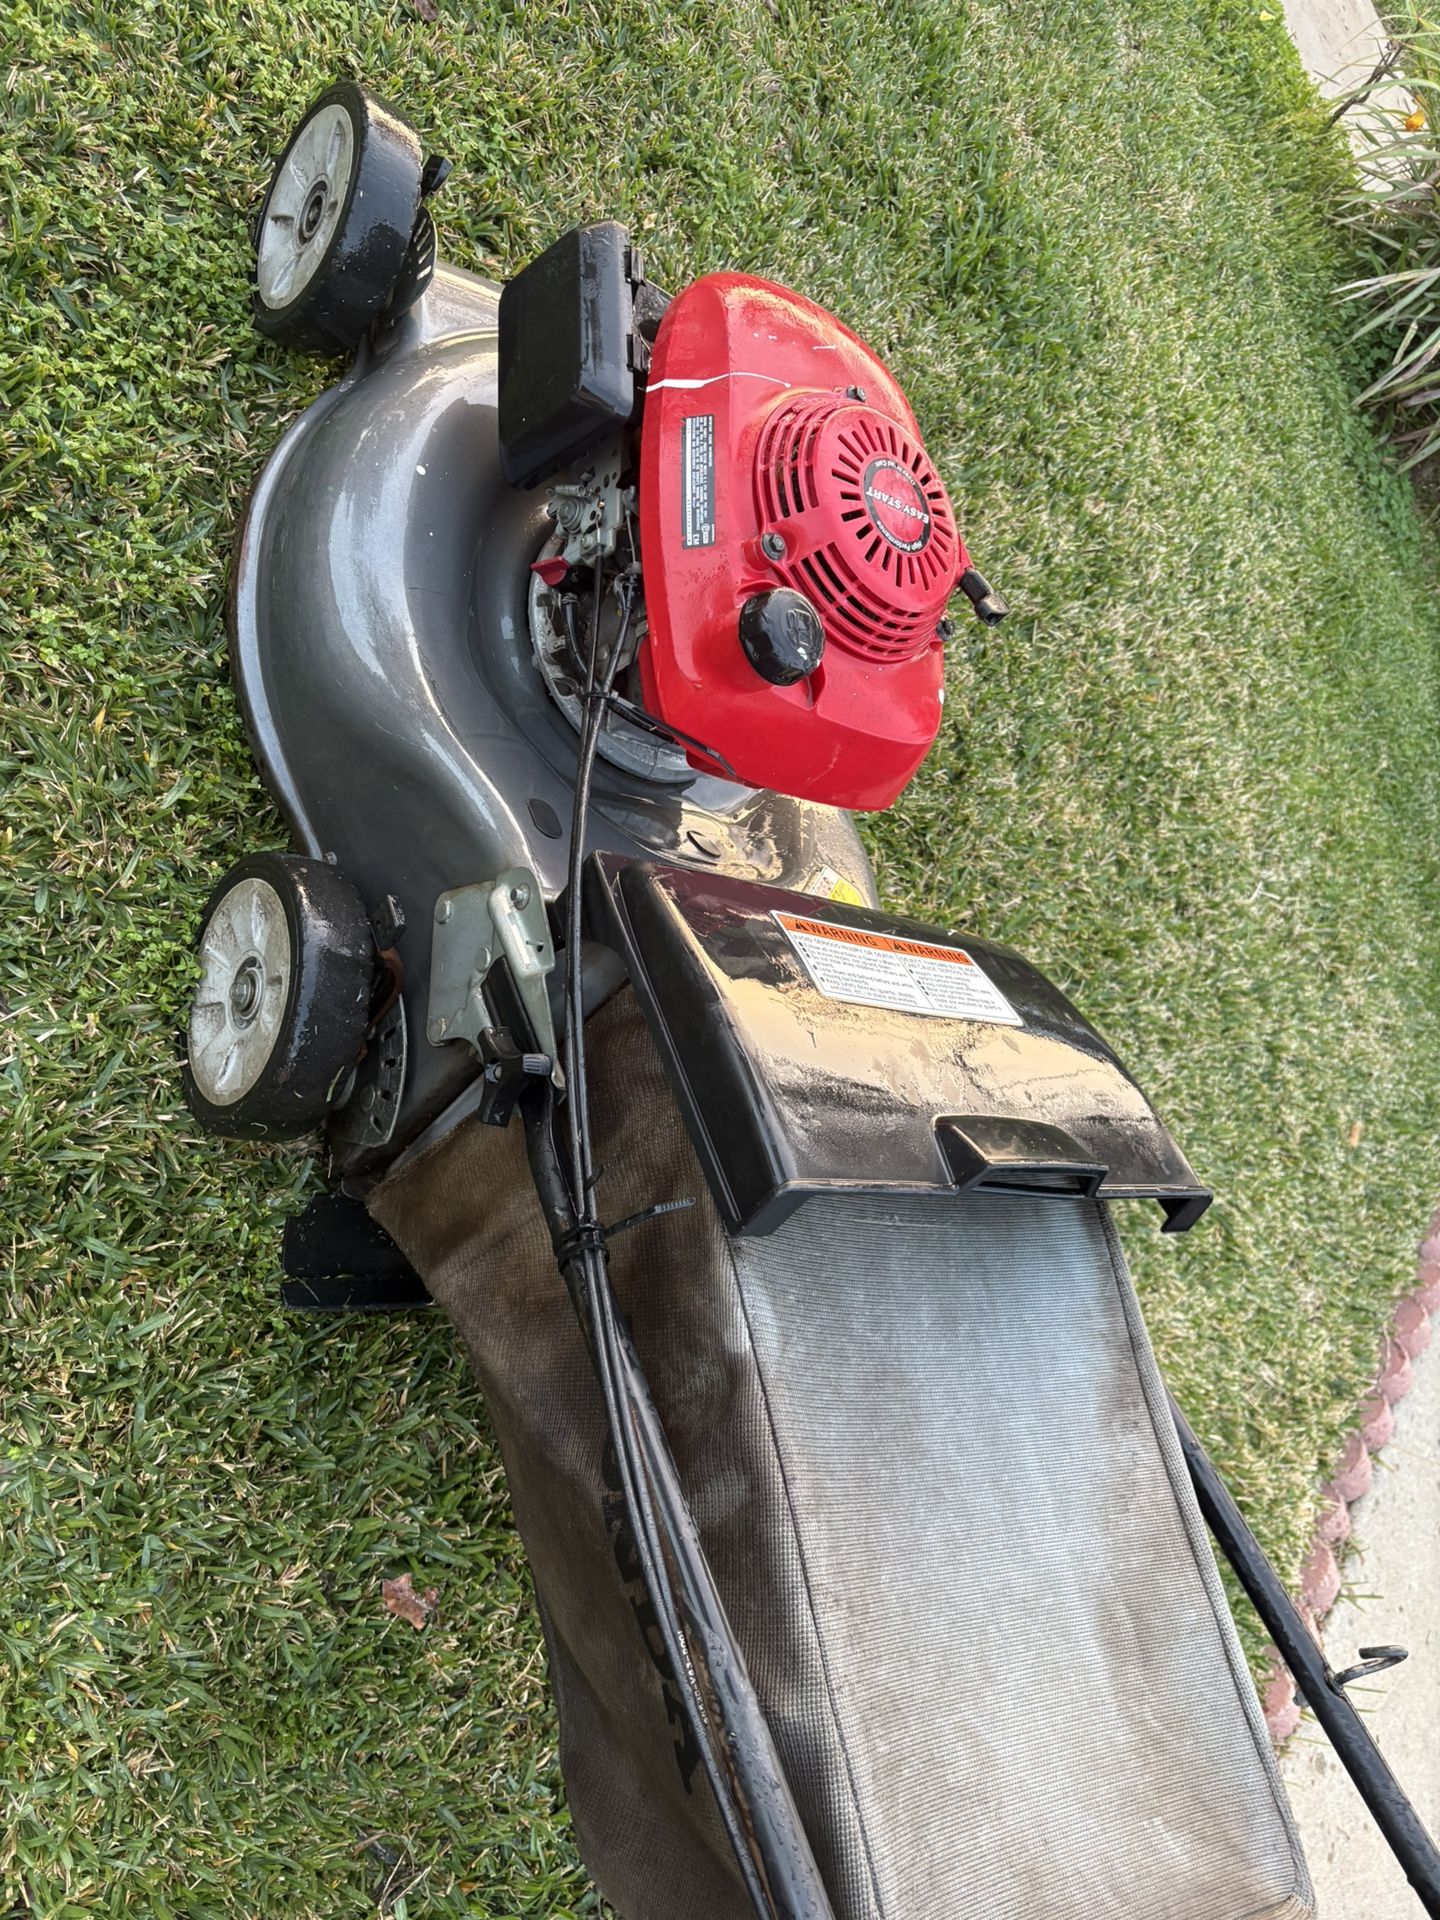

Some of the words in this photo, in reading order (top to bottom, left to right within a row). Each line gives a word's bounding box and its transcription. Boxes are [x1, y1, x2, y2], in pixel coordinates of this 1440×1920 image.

[866, 487, 902, 509] START
[903, 505, 929, 524] EASY
[876, 520, 911, 551] Performance
[911, 541, 923, 551] High
[807, 923, 876, 946] WARNING
[905, 944, 969, 962] WARNING
